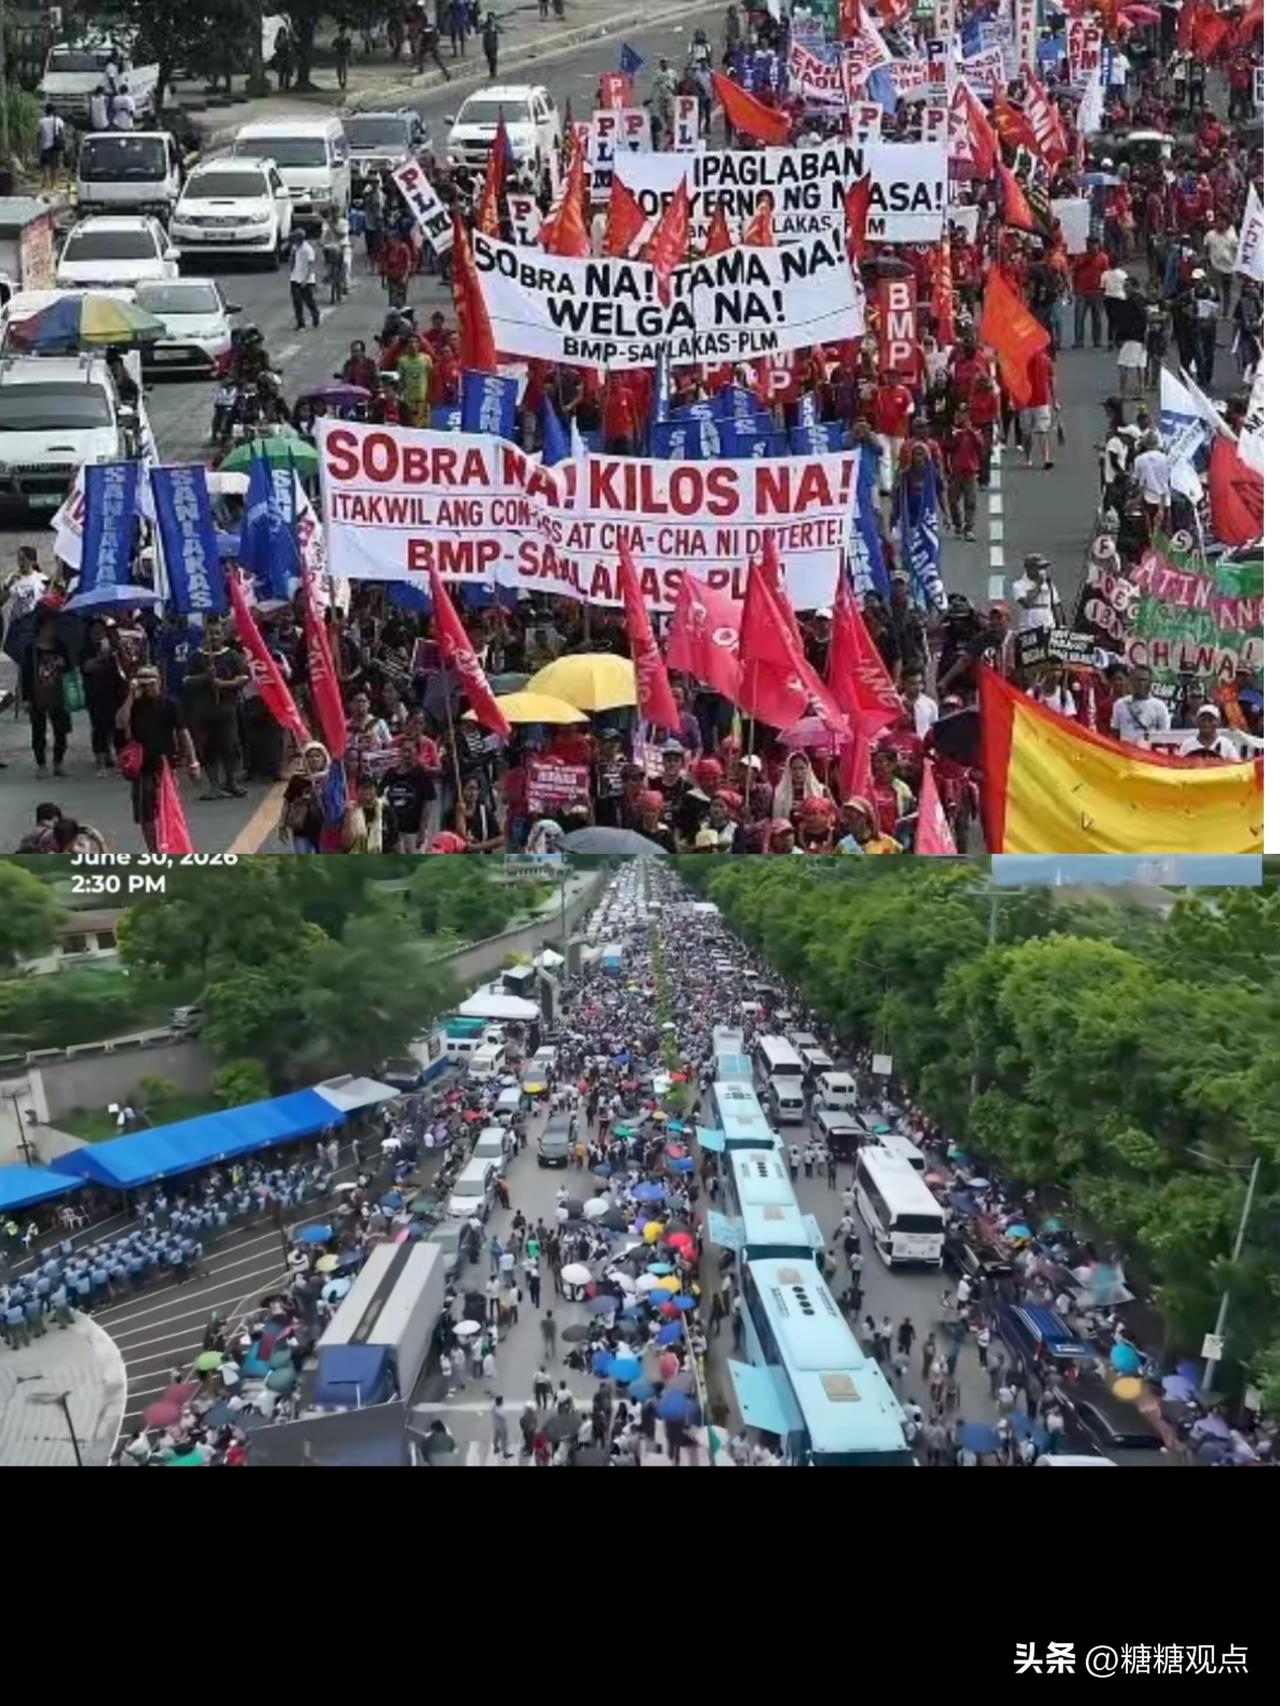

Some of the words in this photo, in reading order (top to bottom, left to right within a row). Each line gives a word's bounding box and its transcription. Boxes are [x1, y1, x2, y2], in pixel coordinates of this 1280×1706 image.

[593, 117, 615, 188] PLM
[693, 147, 863, 187] IPAGLABAN
[399, 166, 454, 239] PLM
[784, 182, 821, 211] NG
[474, 236, 576, 295] SOBRA
[585, 263, 654, 302] NA!
[671, 249, 772, 297] TAMA
[780, 228, 845, 283] NA!
[547, 297, 696, 337] WELGA
[715, 289, 786, 324] NA!
[887, 282, 915, 369] BMP
[326, 429, 490, 485] SOBRA
[502, 446, 577, 509] NA!
[589, 460, 739, 516] KILOS
[755, 459, 855, 515] NA!
[331, 493, 432, 525] ITAKWIL
[436, 500, 483, 526] ANG
[566, 522, 596, 549] AT
[717, 529, 738, 556] NI
[1132, 555, 1213, 608] ATIN
